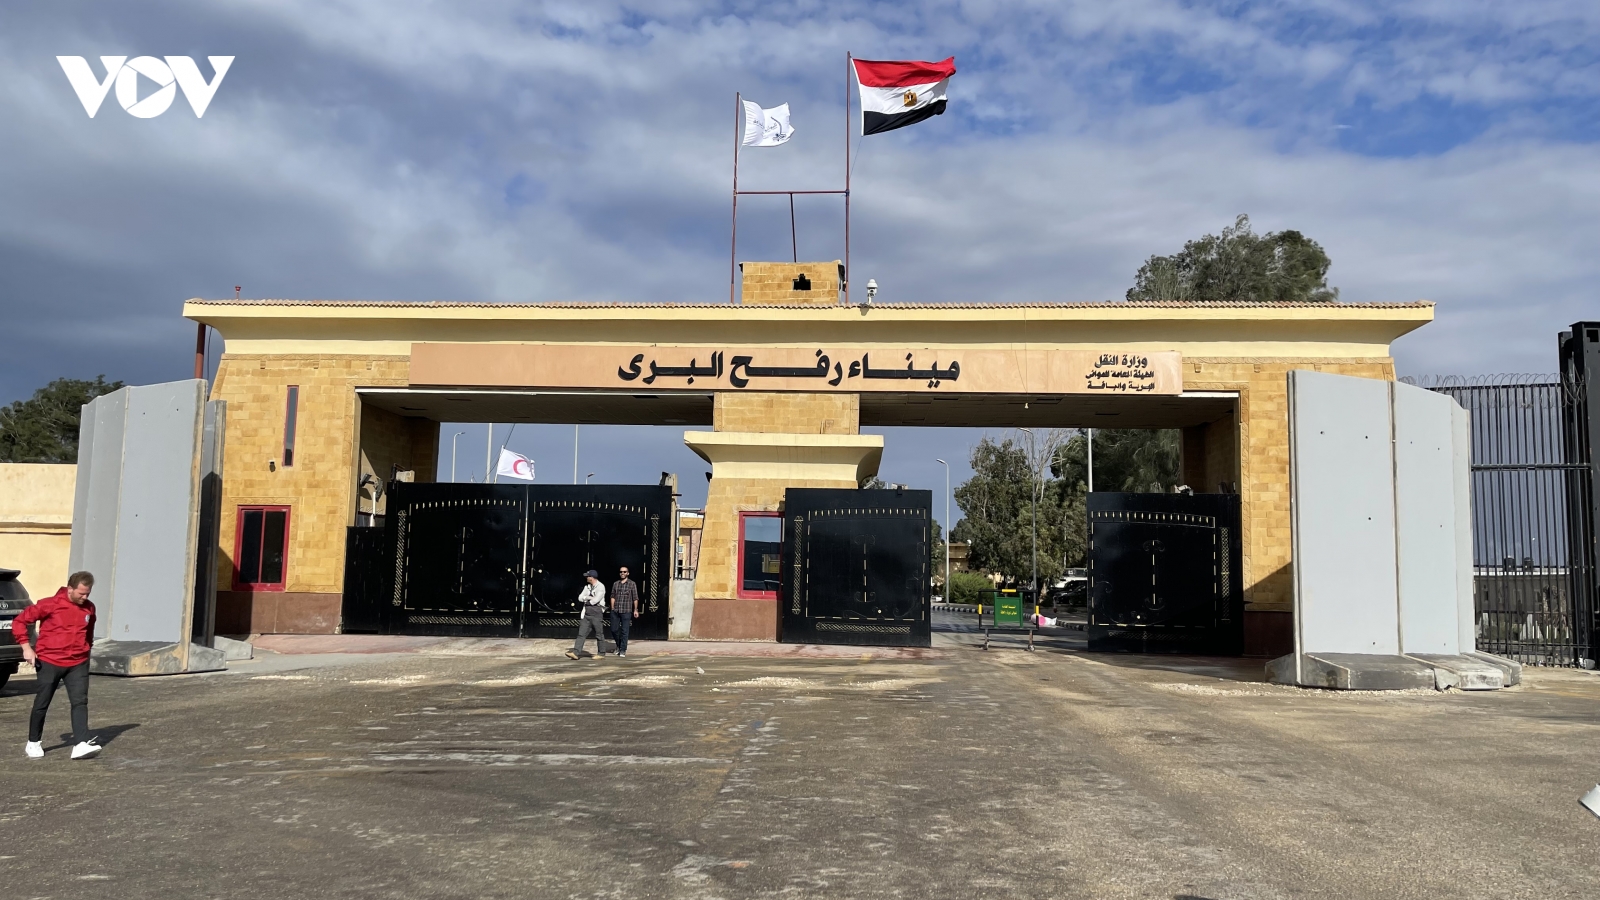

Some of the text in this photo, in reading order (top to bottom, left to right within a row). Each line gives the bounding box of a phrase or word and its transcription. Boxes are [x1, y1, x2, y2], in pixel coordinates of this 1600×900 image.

[729, 348, 844, 388] رفح
[1094, 354, 1148, 368] وزارة النقل
[848, 352, 962, 389] ميناء
[1133, 369, 1155, 380] الهيئة
[1128, 380, 1155, 392] البرية
